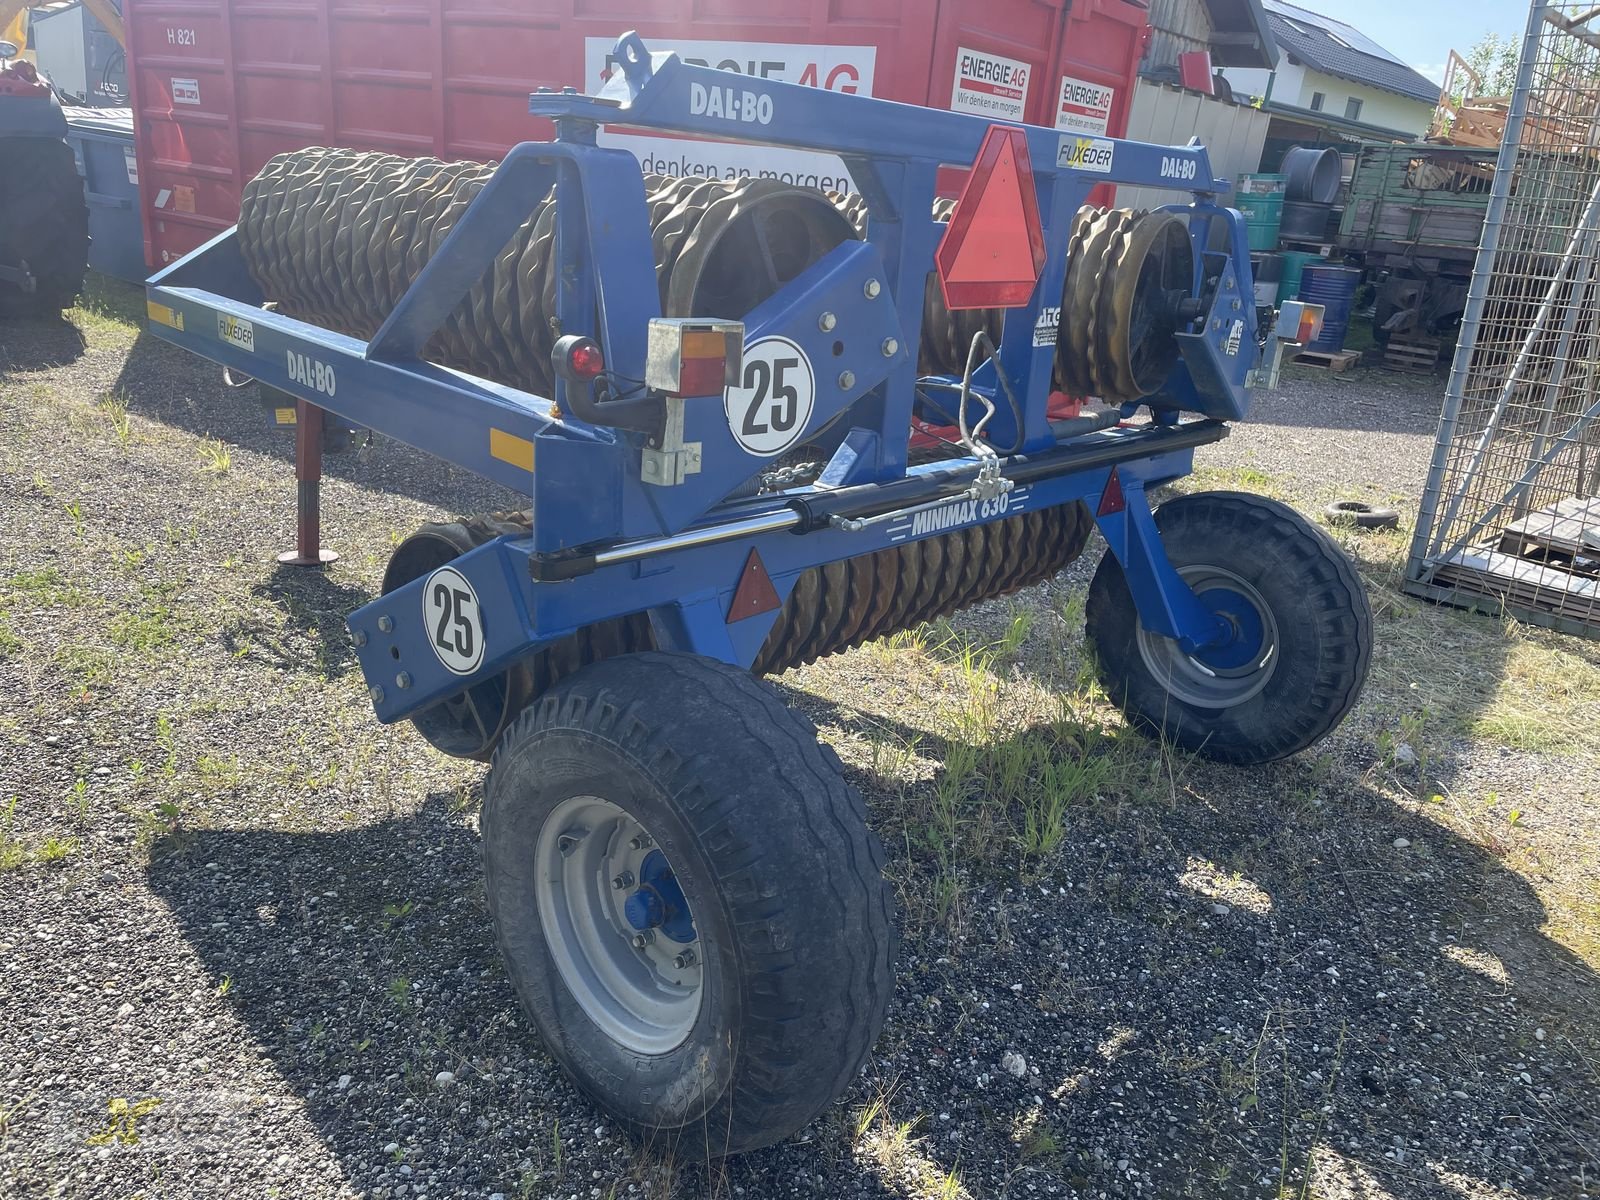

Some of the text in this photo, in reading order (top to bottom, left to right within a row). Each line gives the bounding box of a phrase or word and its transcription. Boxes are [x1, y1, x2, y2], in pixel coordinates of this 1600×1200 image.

[167, 28, 196, 45] H 821
[961, 55, 1026, 88] ENERGIE AG
[957, 91, 1021, 115] Wir denken an morgen
[1063, 83, 1110, 108] ENERGIE AG
[1058, 144, 1112, 166] FLIXEDER
[218, 320, 253, 345] FLIXEDER
[741, 357, 799, 436] 25
[911, 492, 1009, 536] MINIMAX 630
[433, 583, 474, 658] 25
